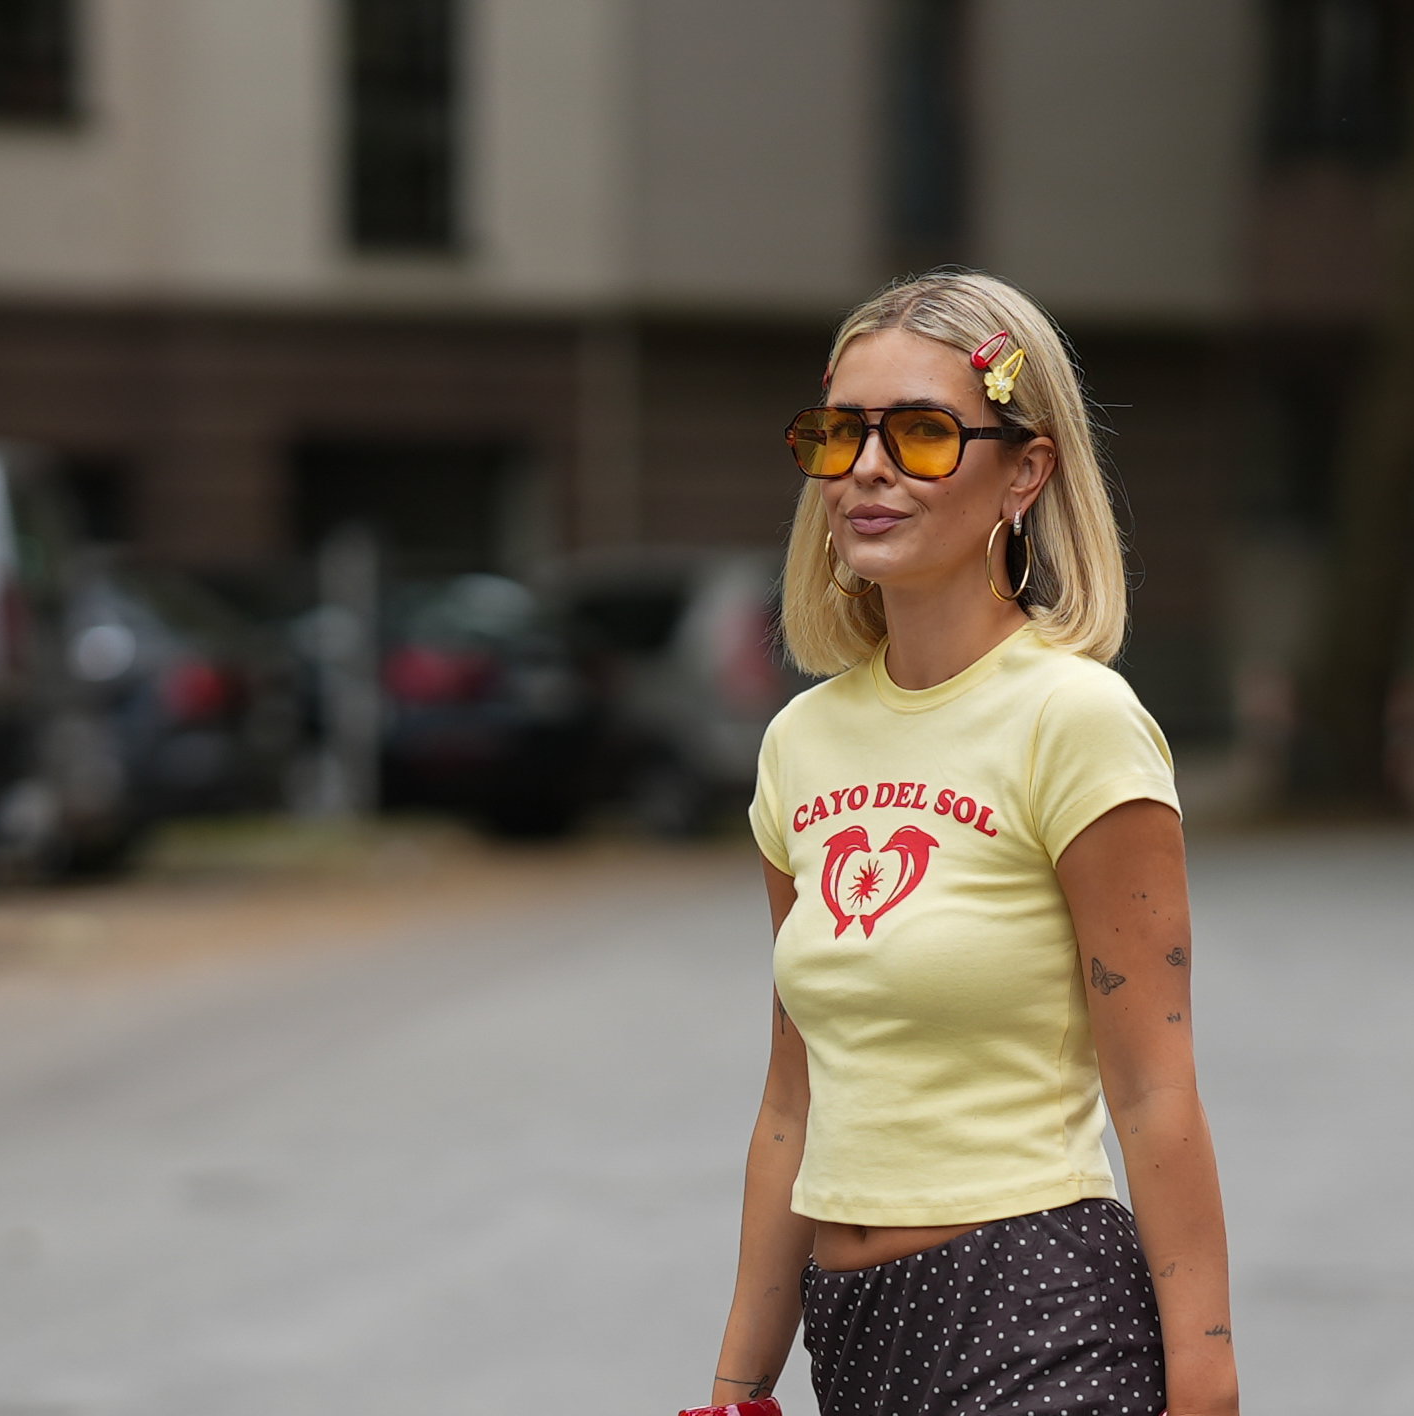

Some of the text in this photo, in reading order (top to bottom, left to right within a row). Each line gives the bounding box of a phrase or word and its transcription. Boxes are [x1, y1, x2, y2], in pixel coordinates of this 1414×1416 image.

[792, 782, 999, 838] CAYO DEL SOL
